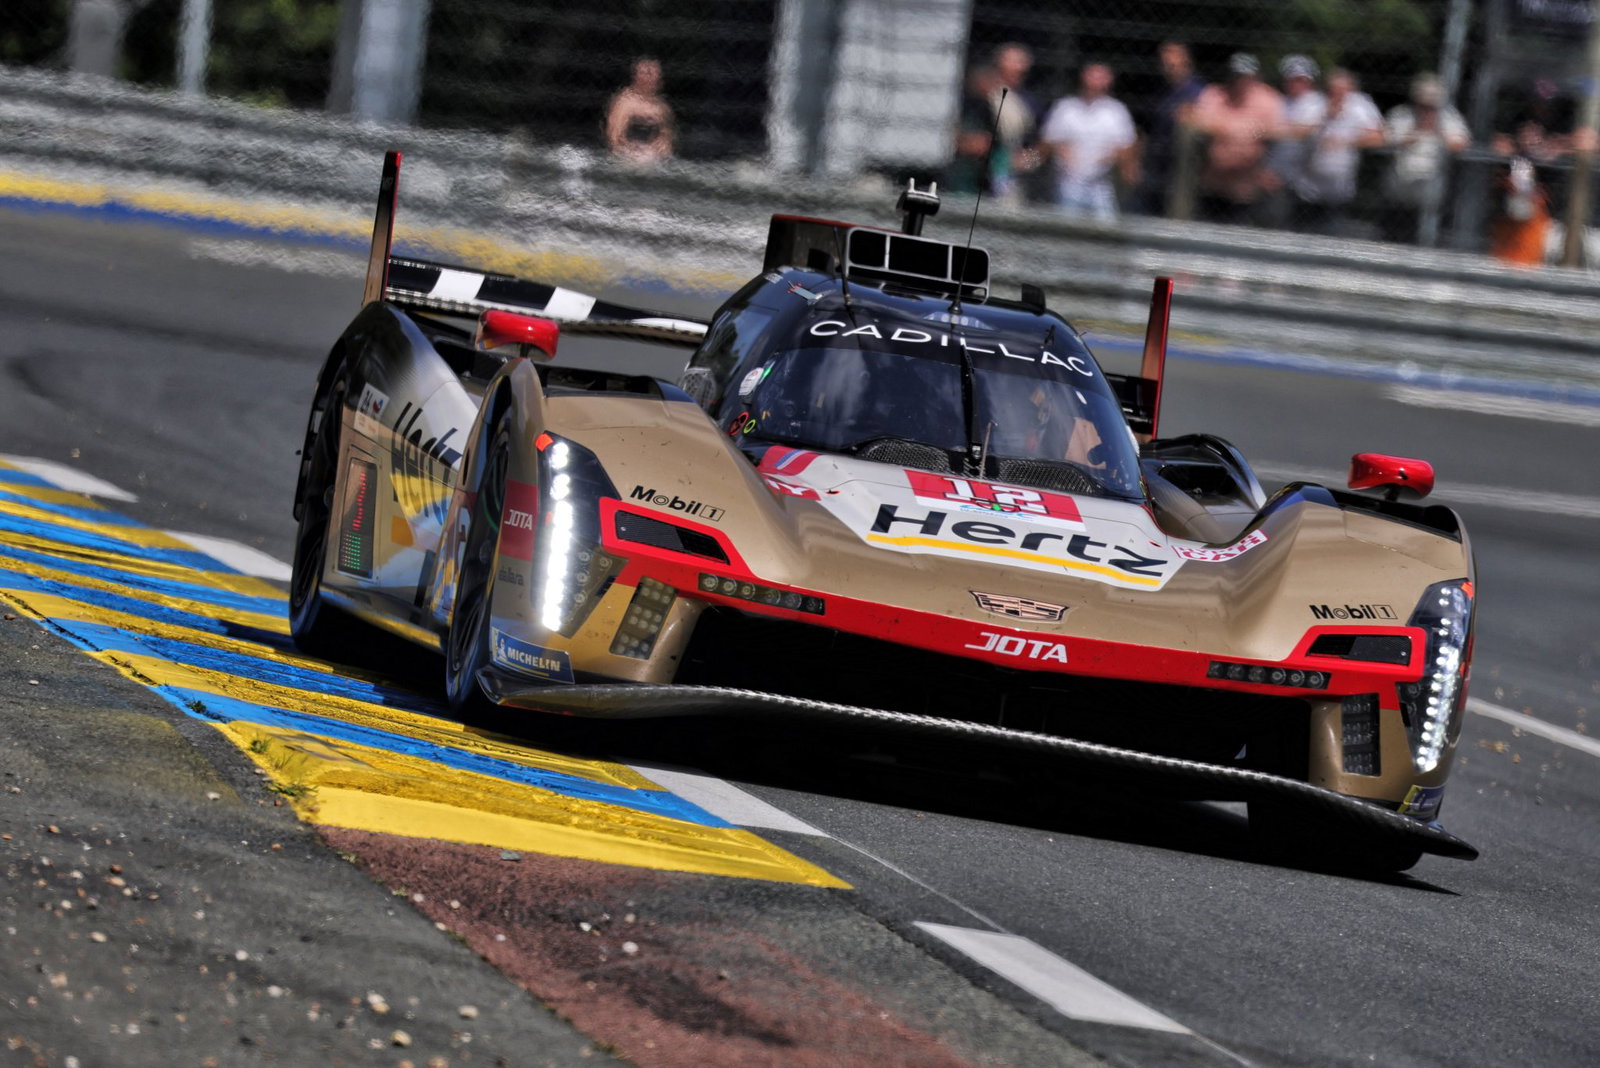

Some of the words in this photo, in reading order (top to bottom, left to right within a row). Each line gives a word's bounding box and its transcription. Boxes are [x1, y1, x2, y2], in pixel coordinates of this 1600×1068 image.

[810, 320, 1093, 377] CADILLAC
[630, 484, 702, 515] Mobil
[943, 477, 1050, 514] 12
[504, 509, 533, 530] JOTA
[870, 503, 1168, 577] Hertz
[1309, 604, 1377, 619] Mobil
[507, 646, 561, 672] MICHELIN
[964, 631, 1068, 664] JOTA
